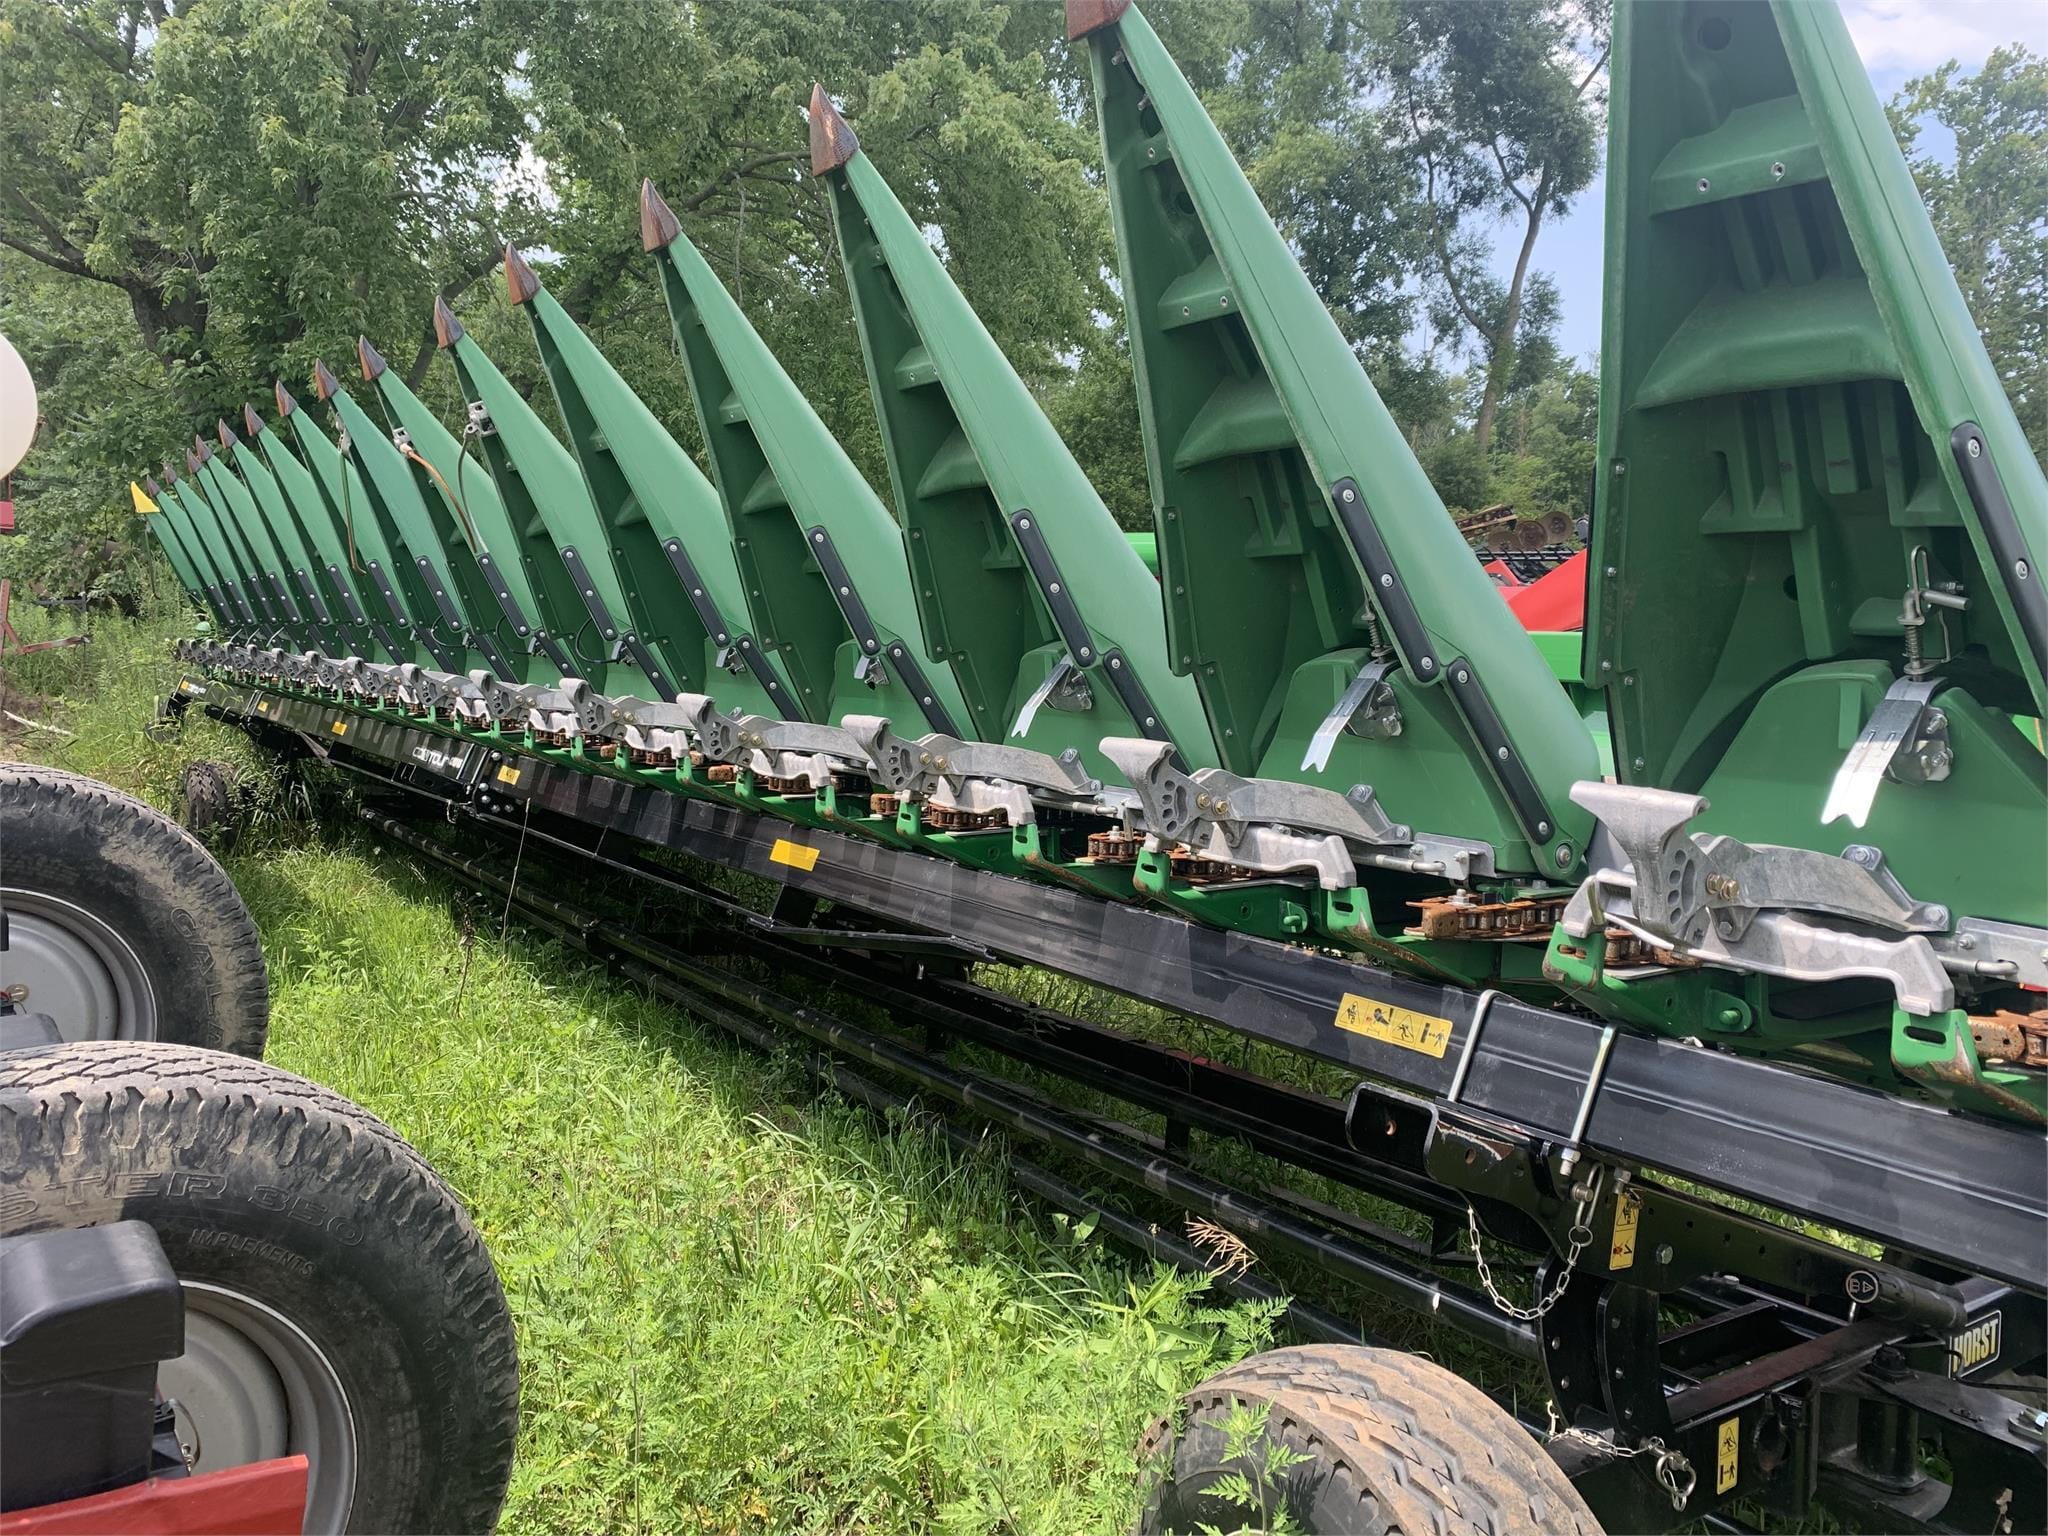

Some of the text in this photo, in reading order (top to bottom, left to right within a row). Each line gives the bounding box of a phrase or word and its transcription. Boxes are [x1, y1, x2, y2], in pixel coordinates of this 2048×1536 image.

[248, 1184, 365, 1246] 350
[188, 1227, 318, 1278] IMPLEMENTS
[1952, 1318, 1999, 1373] HORST
